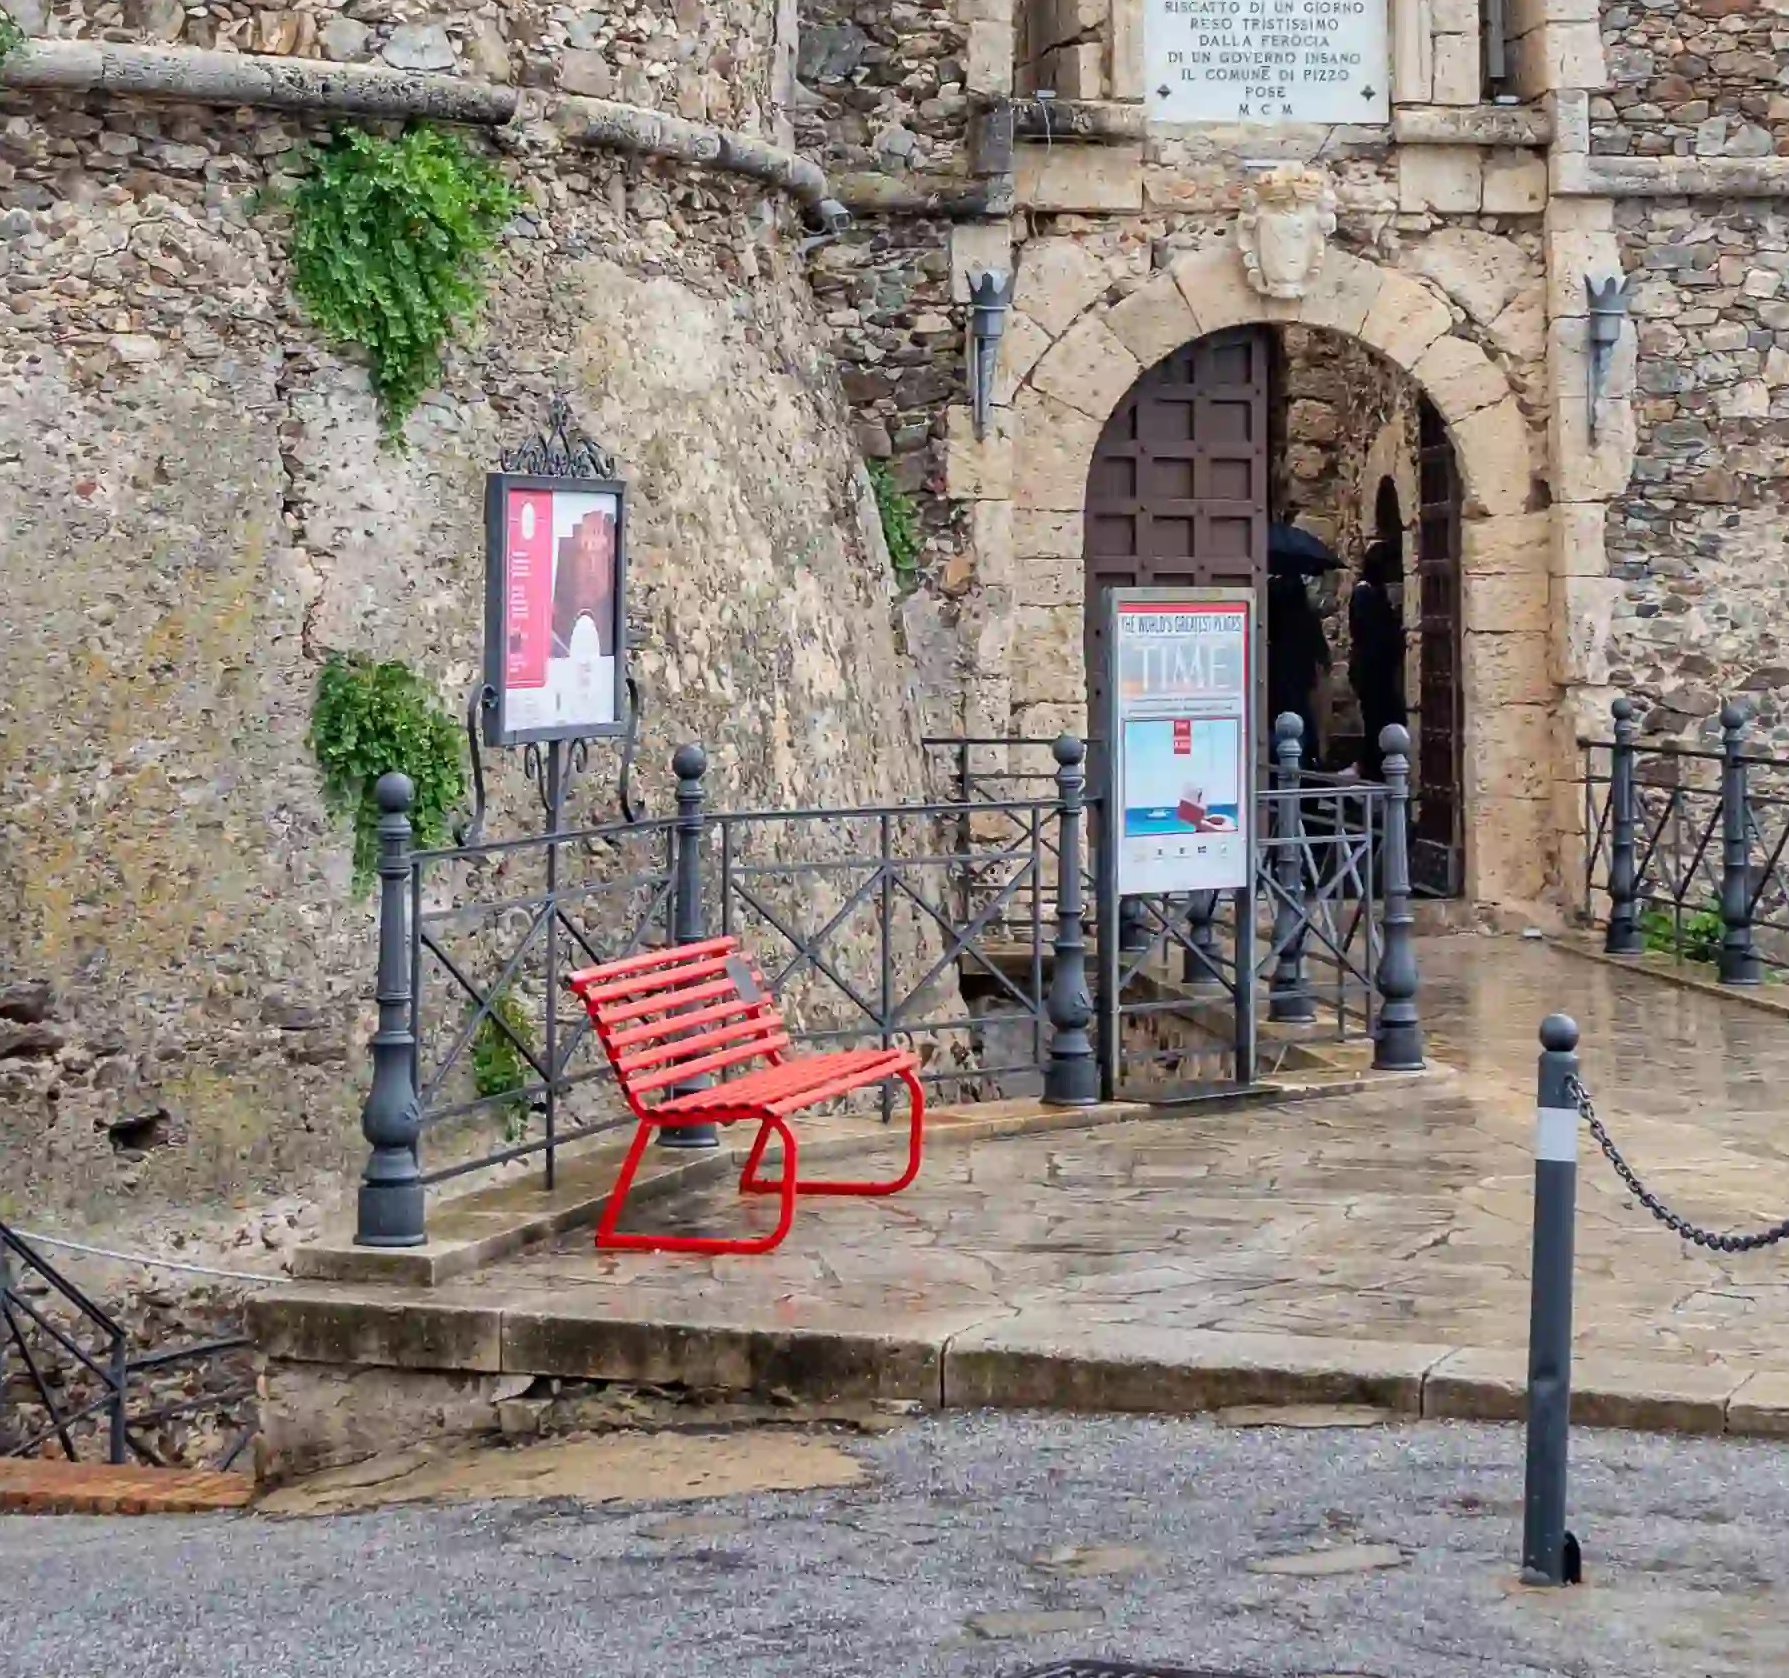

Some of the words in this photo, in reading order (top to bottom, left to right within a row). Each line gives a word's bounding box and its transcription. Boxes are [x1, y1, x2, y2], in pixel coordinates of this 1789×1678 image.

[1164, 1, 1240, 14] RISCATTO
[1250, 1, 1266, 14] DI
[1274, 1, 1294, 14] UN
[1303, 1, 1365, 14] GIORNO
[1190, 18, 1233, 31] RESO
[1242, 18, 1339, 31] TRISTISSIMO
[1198, 35, 1252, 47] DALLA
[1261, 35, 1330, 47] FEROCIA
[1167, 52, 1183, 64] DI
[1191, 52, 1211, 64] UN
[1219, 52, 1296, 64] GOVERNO
[1305, 52, 1361, 64] INSANO
[1181, 69, 1195, 81] IL
[1205, 69, 1271, 81] COMUNE
[1279, 69, 1294, 81] DI
[1303, 69, 1350, 81] PIZZO
[1245, 86, 1287, 98] POSE
[1133, 644, 1231, 691] TIME
